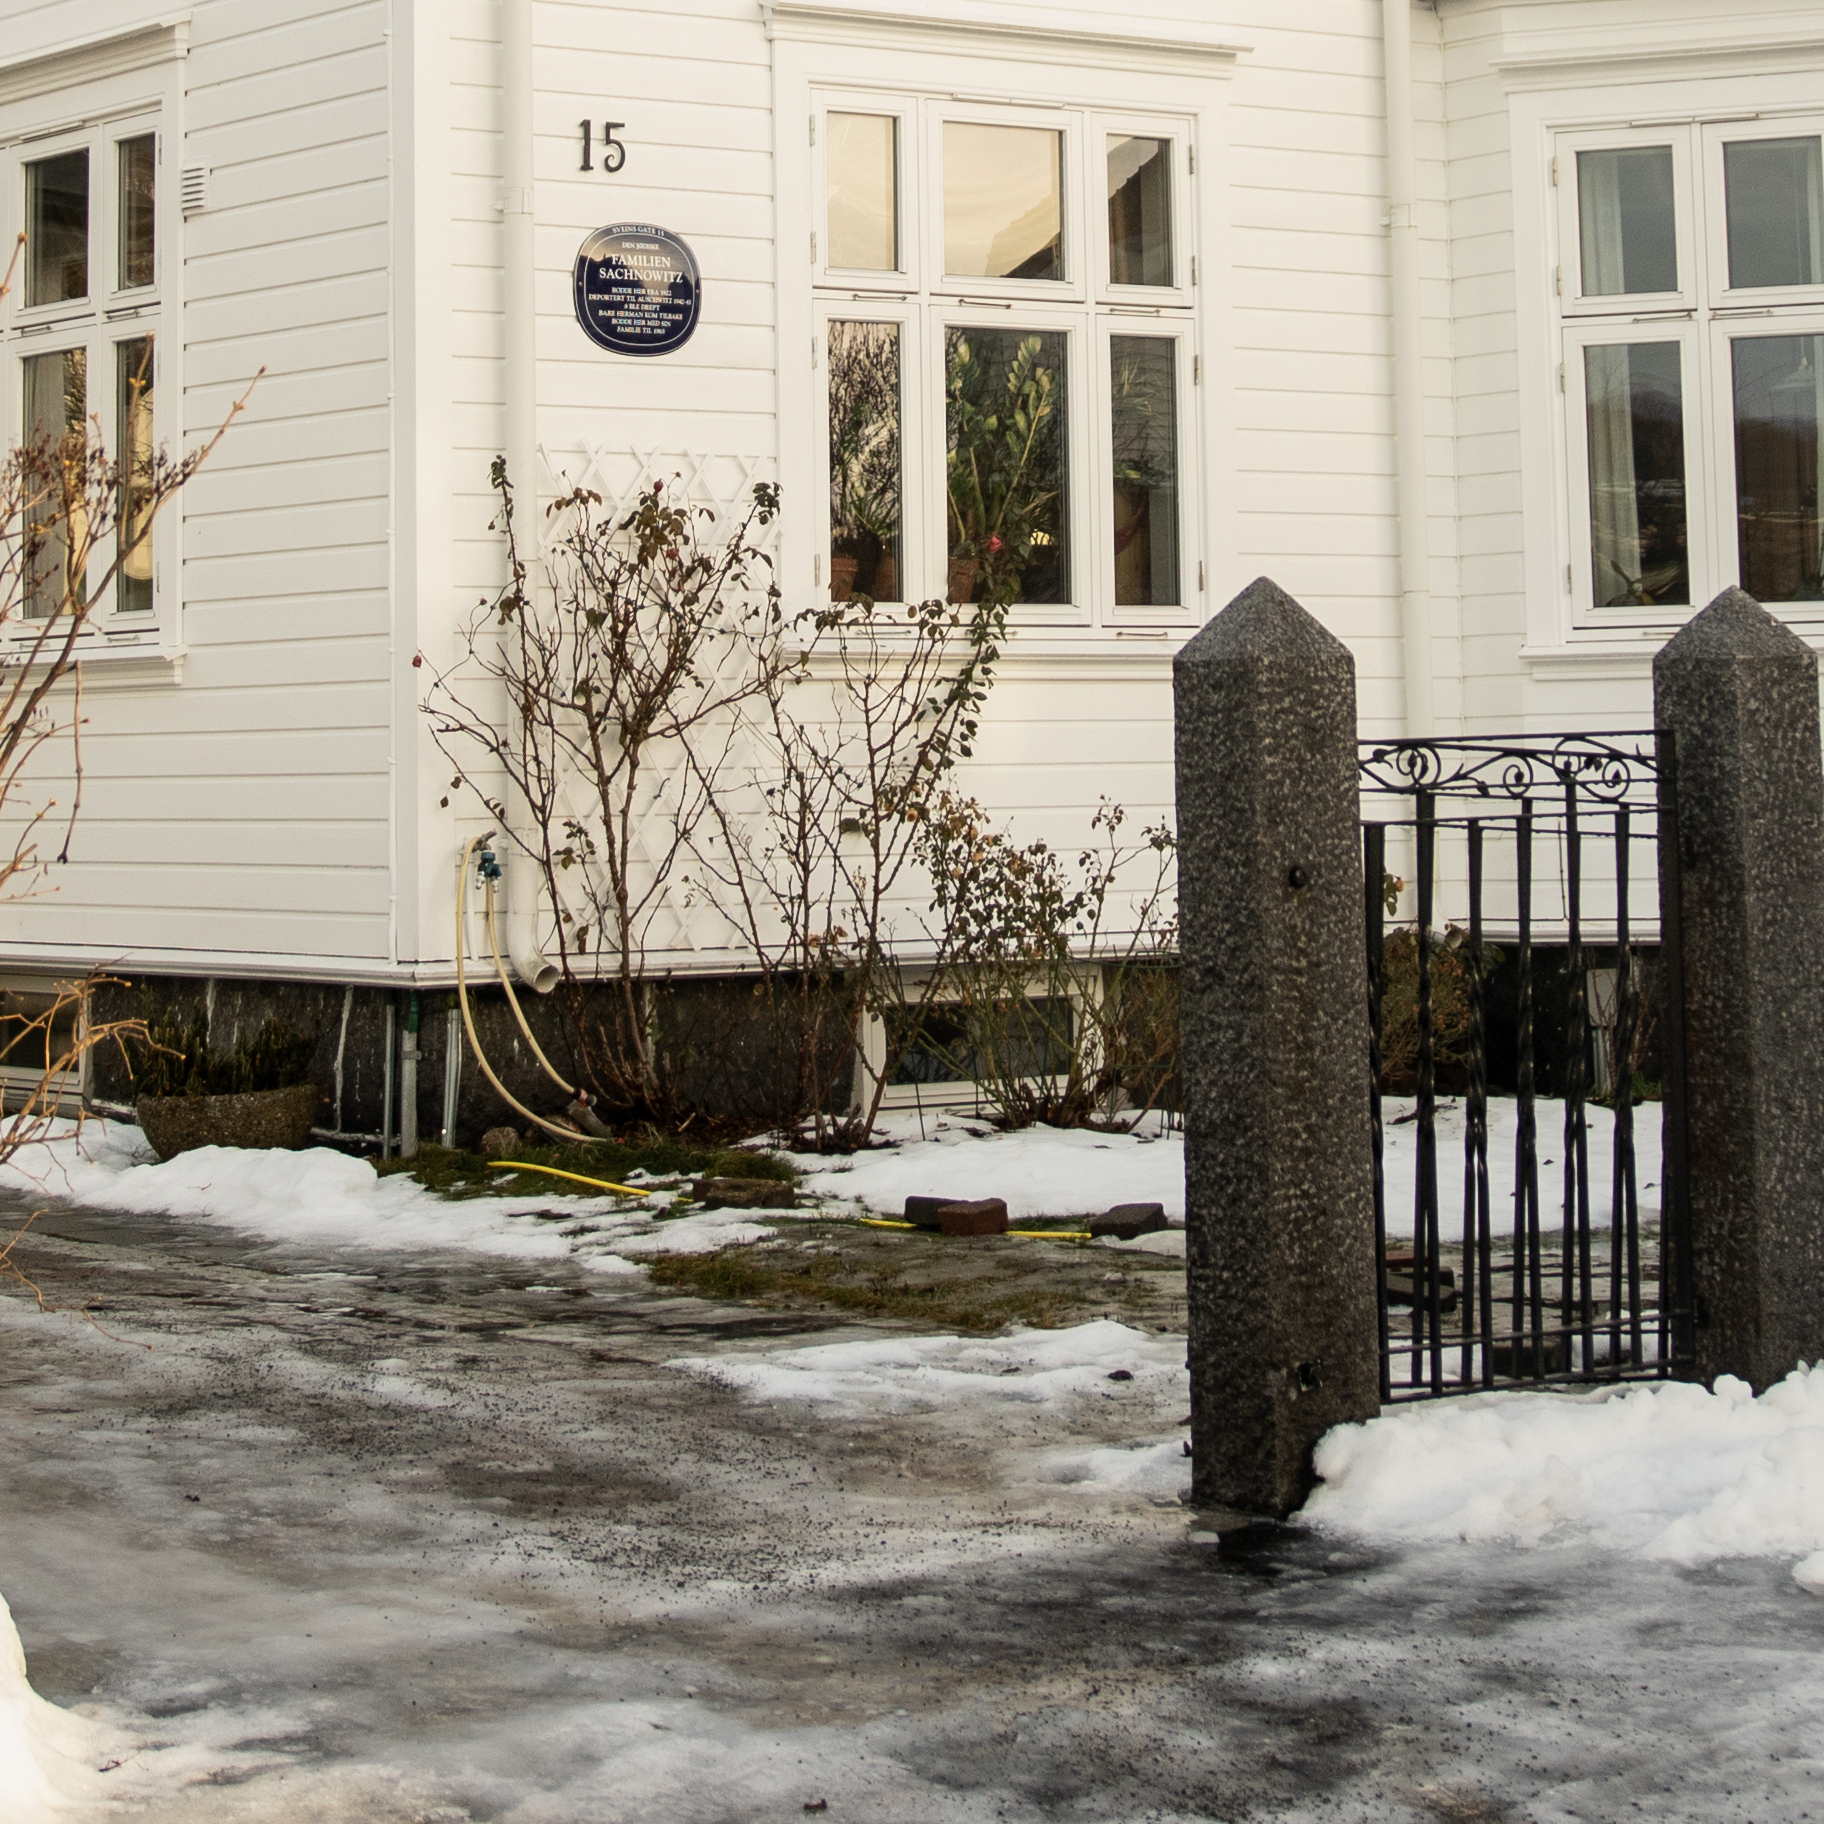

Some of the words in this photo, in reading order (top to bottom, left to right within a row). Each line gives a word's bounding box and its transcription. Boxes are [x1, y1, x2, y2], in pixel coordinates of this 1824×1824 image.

[578, 119, 626, 173] 15
[612, 225, 637, 234] SVEINS
[637, 226, 656, 234] GATE
[622, 241, 635, 249] DEN
[611, 253, 671, 268] FAMILIEN
[599, 267, 684, 283] SACHNOWITZ
[611, 286, 632, 294] BODDE
[633, 287, 646, 295] HER
[588, 293, 625, 301] DEPORTERT
[637, 296, 673, 304] AUSCHWITZ
[598, 309, 616, 317] BARE
[616, 310, 644, 318] HERMAN
[659, 312, 683, 320] TILBAKE
[633, 318, 646, 326] HER
